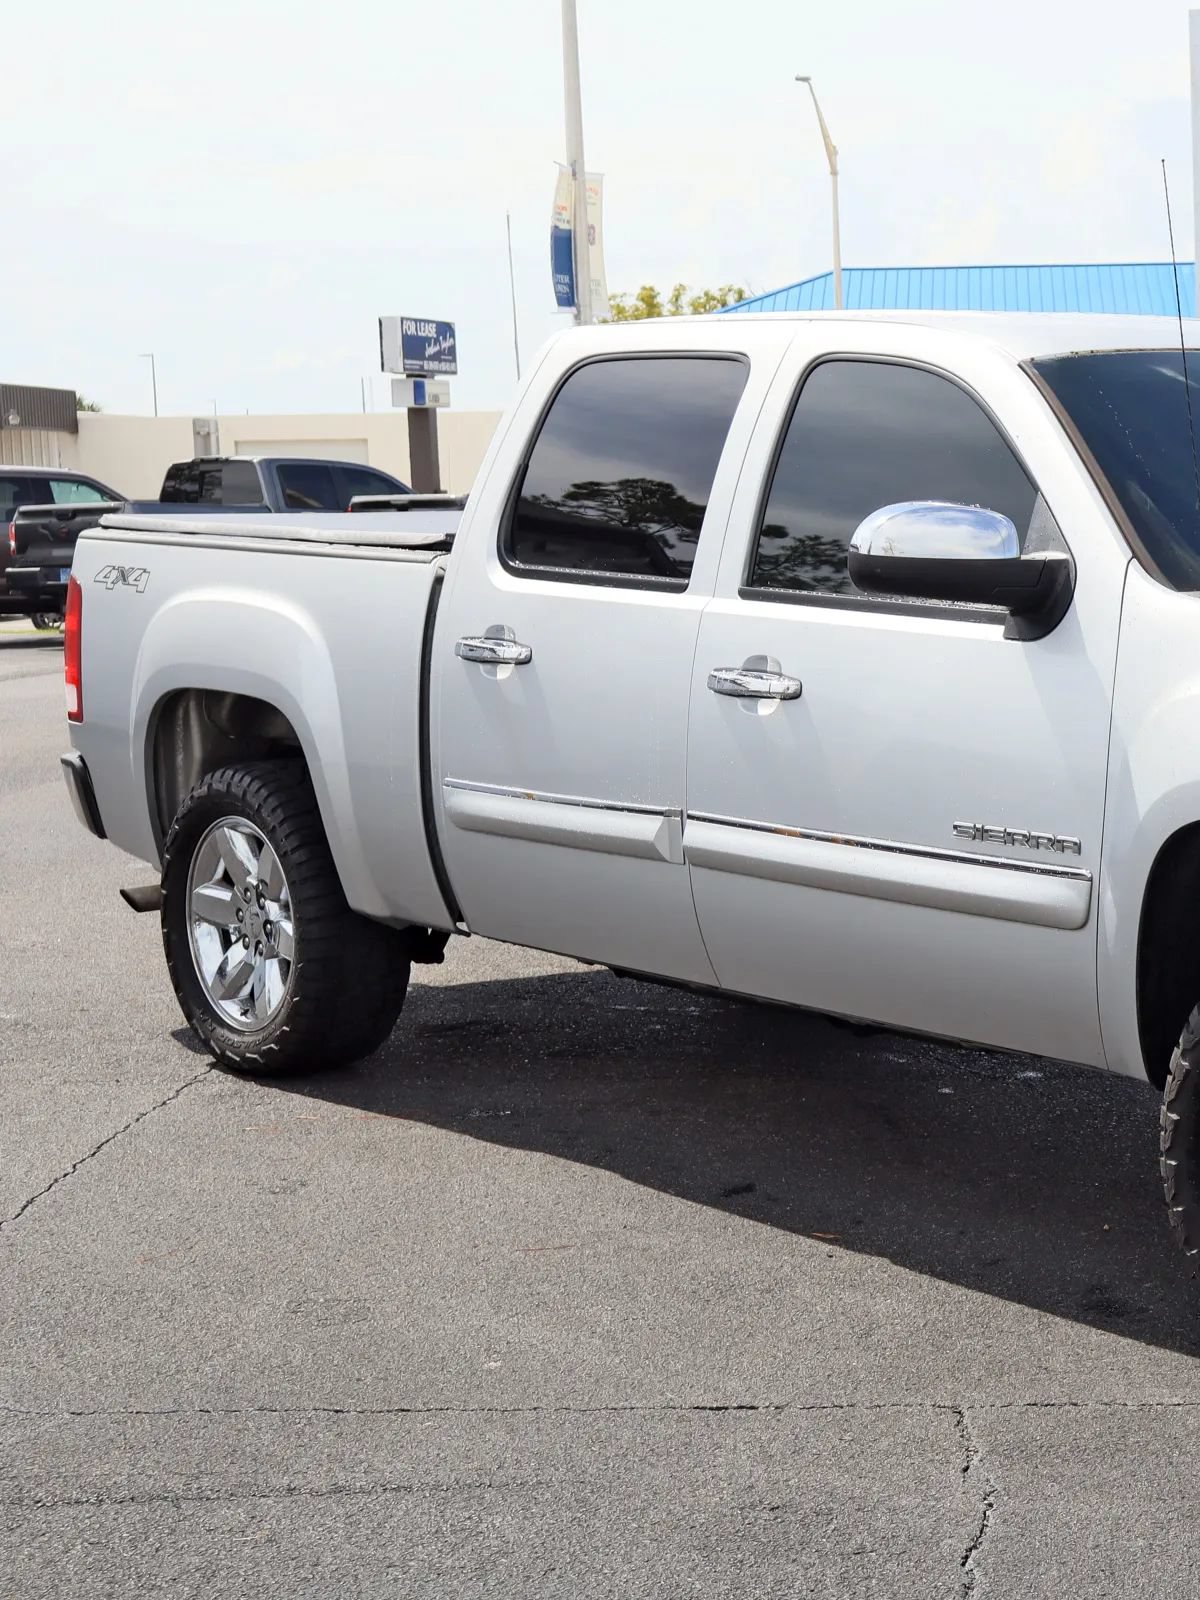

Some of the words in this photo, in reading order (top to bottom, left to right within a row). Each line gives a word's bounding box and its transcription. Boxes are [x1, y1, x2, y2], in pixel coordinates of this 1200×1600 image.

[403, 321, 416, 336] FOR
[417, 321, 437, 338] LEASE
[952, 820, 1082, 856] SIERRA
